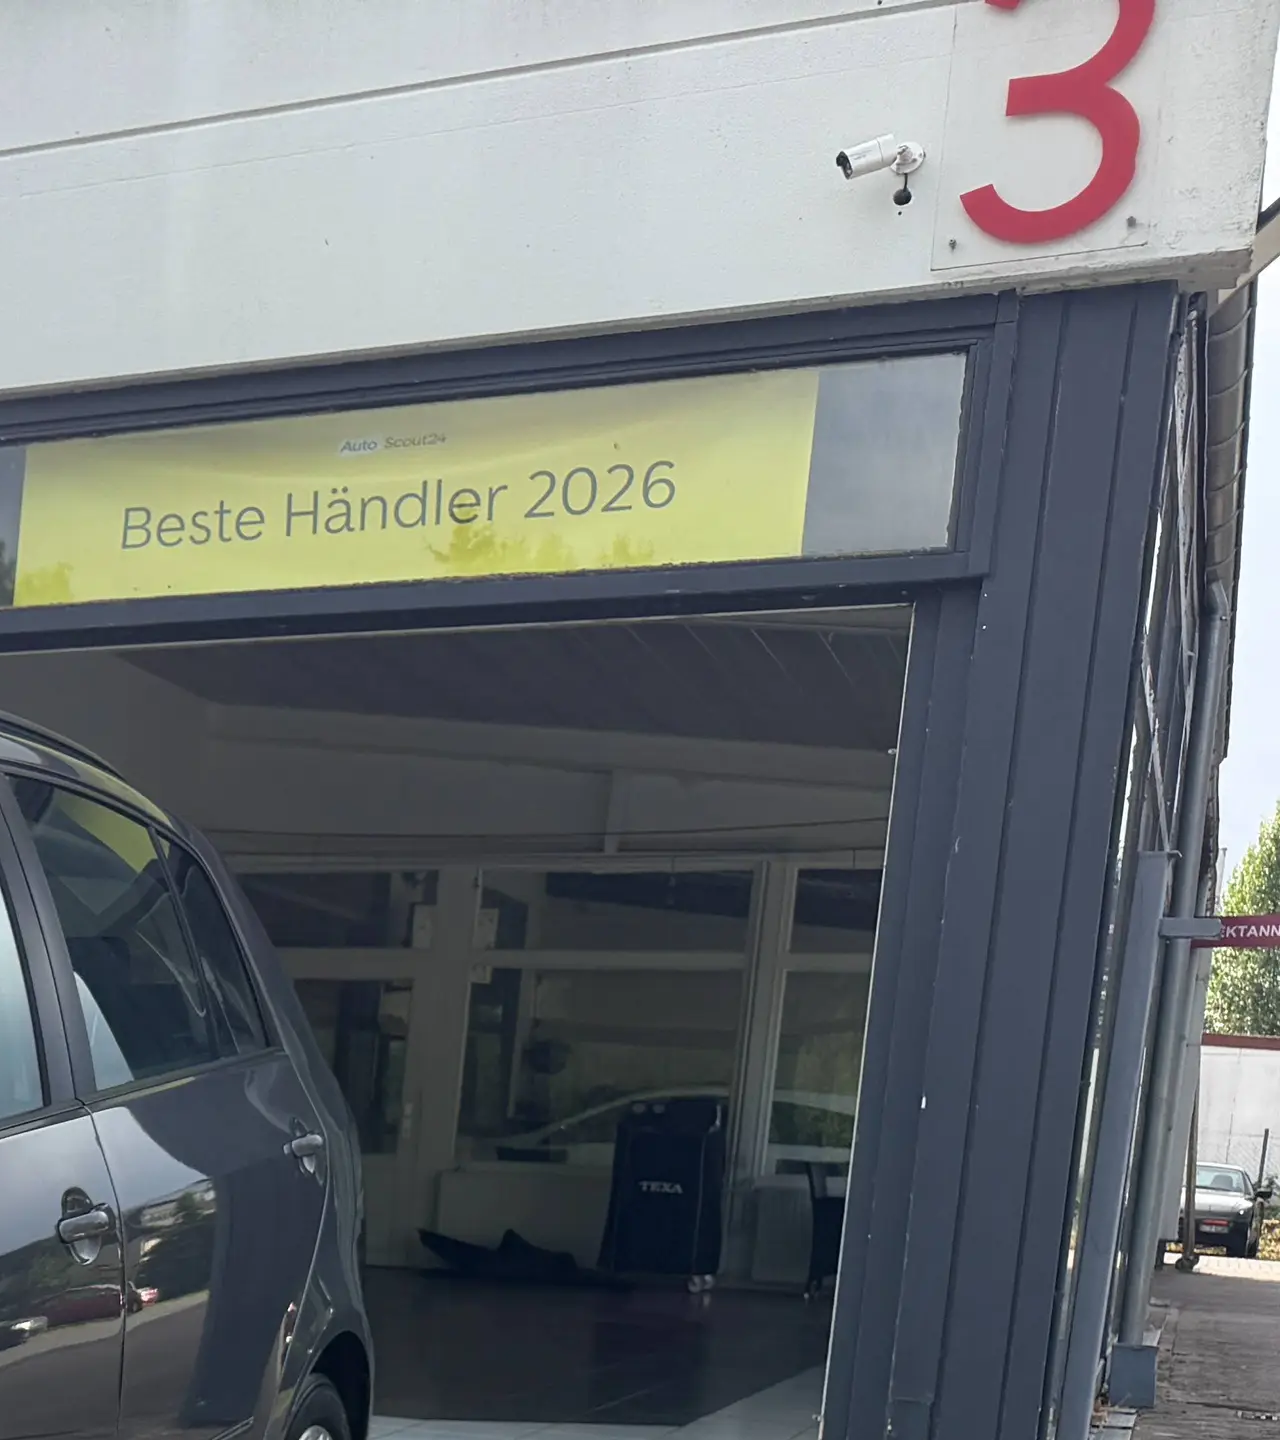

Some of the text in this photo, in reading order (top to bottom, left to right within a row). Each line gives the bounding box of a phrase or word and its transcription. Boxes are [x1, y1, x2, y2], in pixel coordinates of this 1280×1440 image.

[959, 0, 1156, 245] 3
[121, 460, 676, 550] Beste Händler 2026
